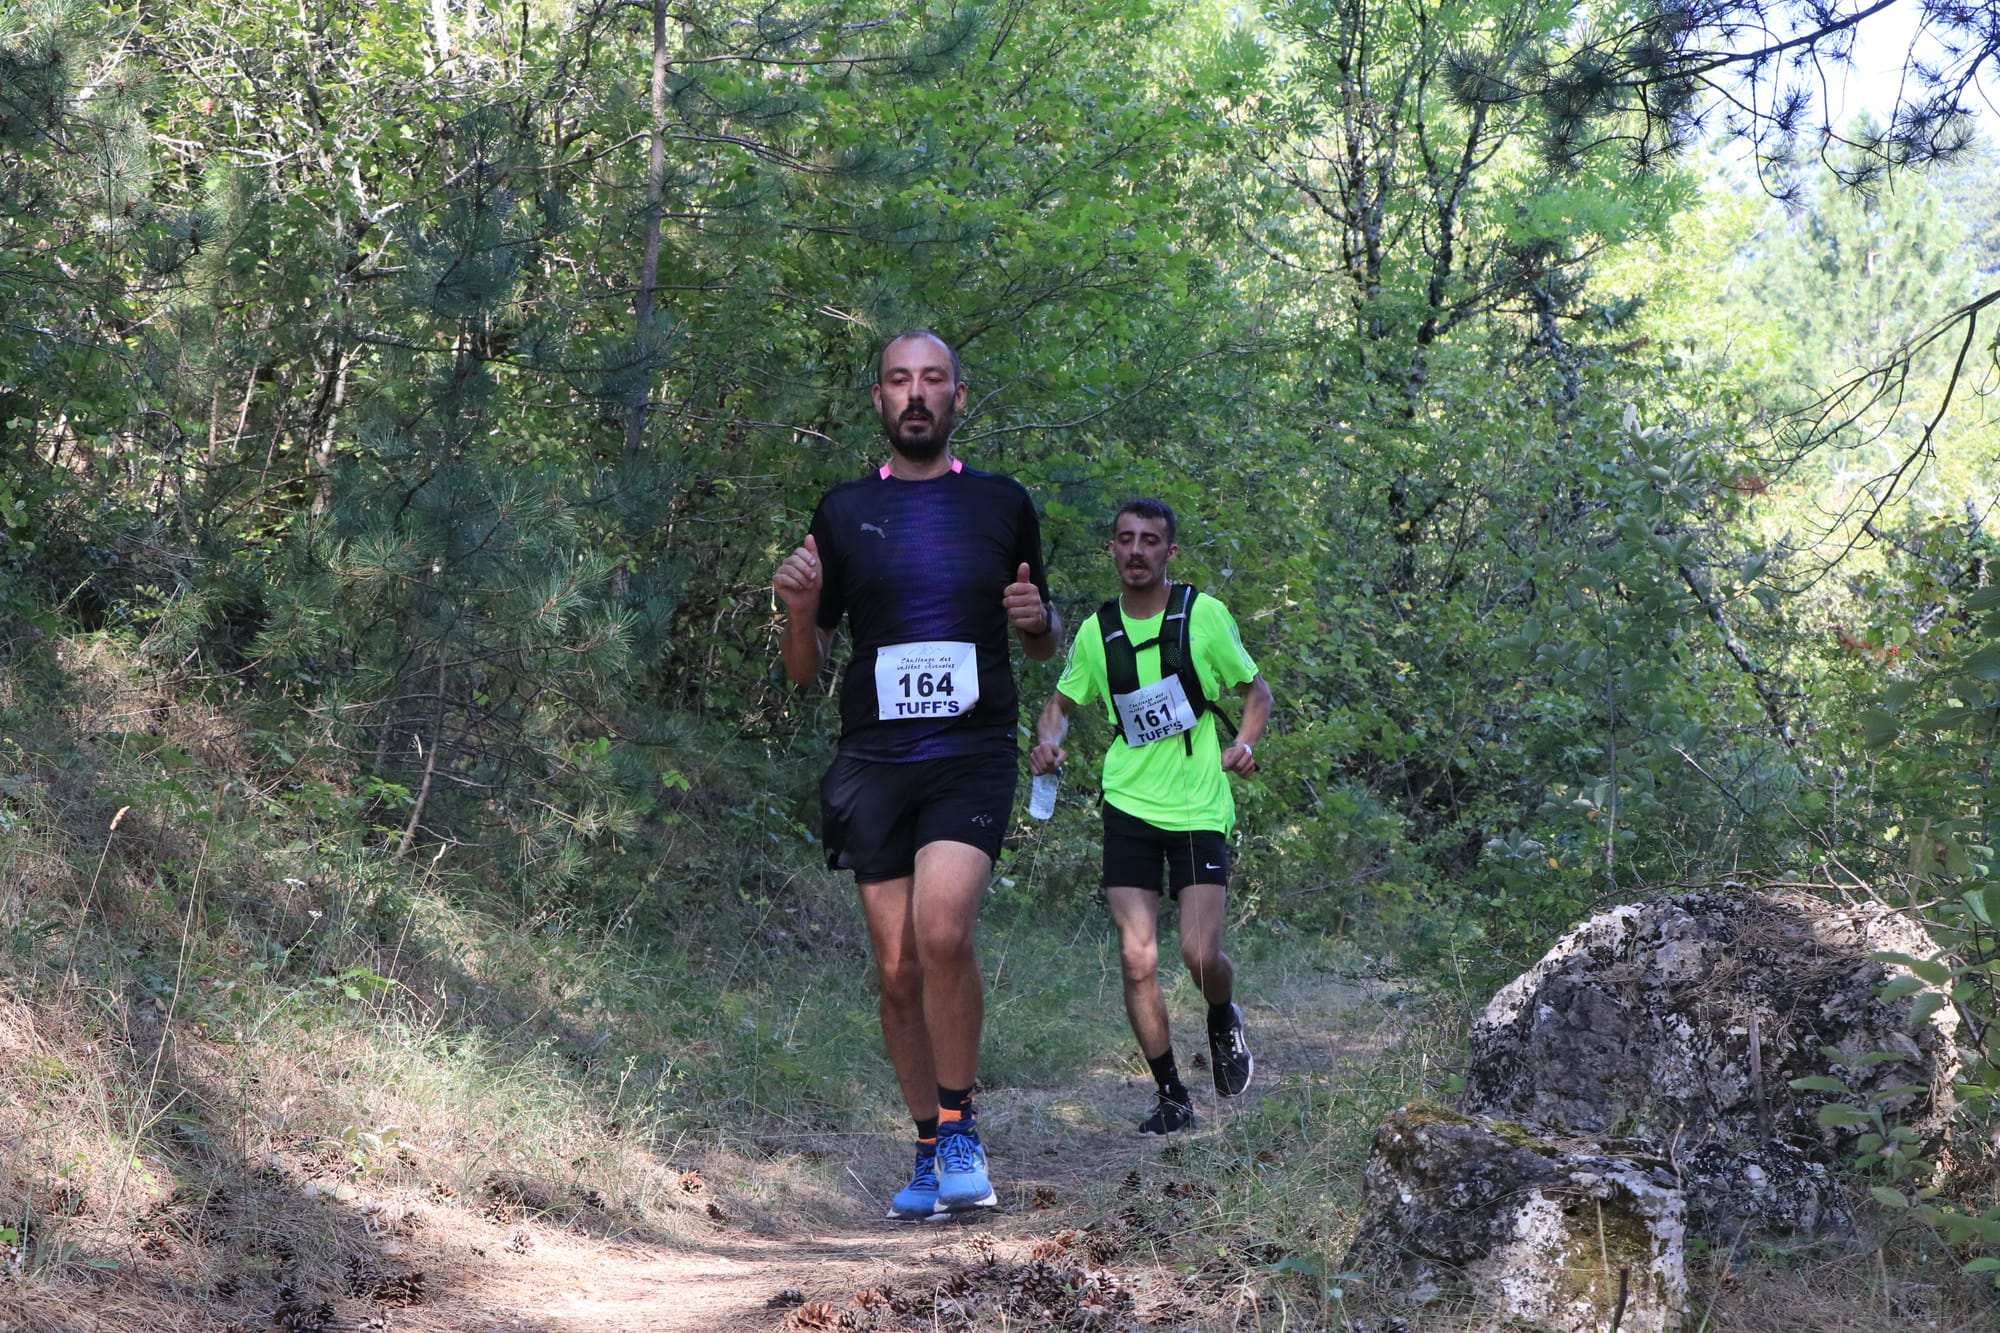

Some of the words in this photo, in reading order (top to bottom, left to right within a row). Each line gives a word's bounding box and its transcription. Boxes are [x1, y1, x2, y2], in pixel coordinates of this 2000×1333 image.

[899, 672, 954, 698] 164
[895, 700, 960, 715] TUFF'S
[1133, 703, 1172, 731] 161
[1138, 721, 1183, 743] TUFF'S
